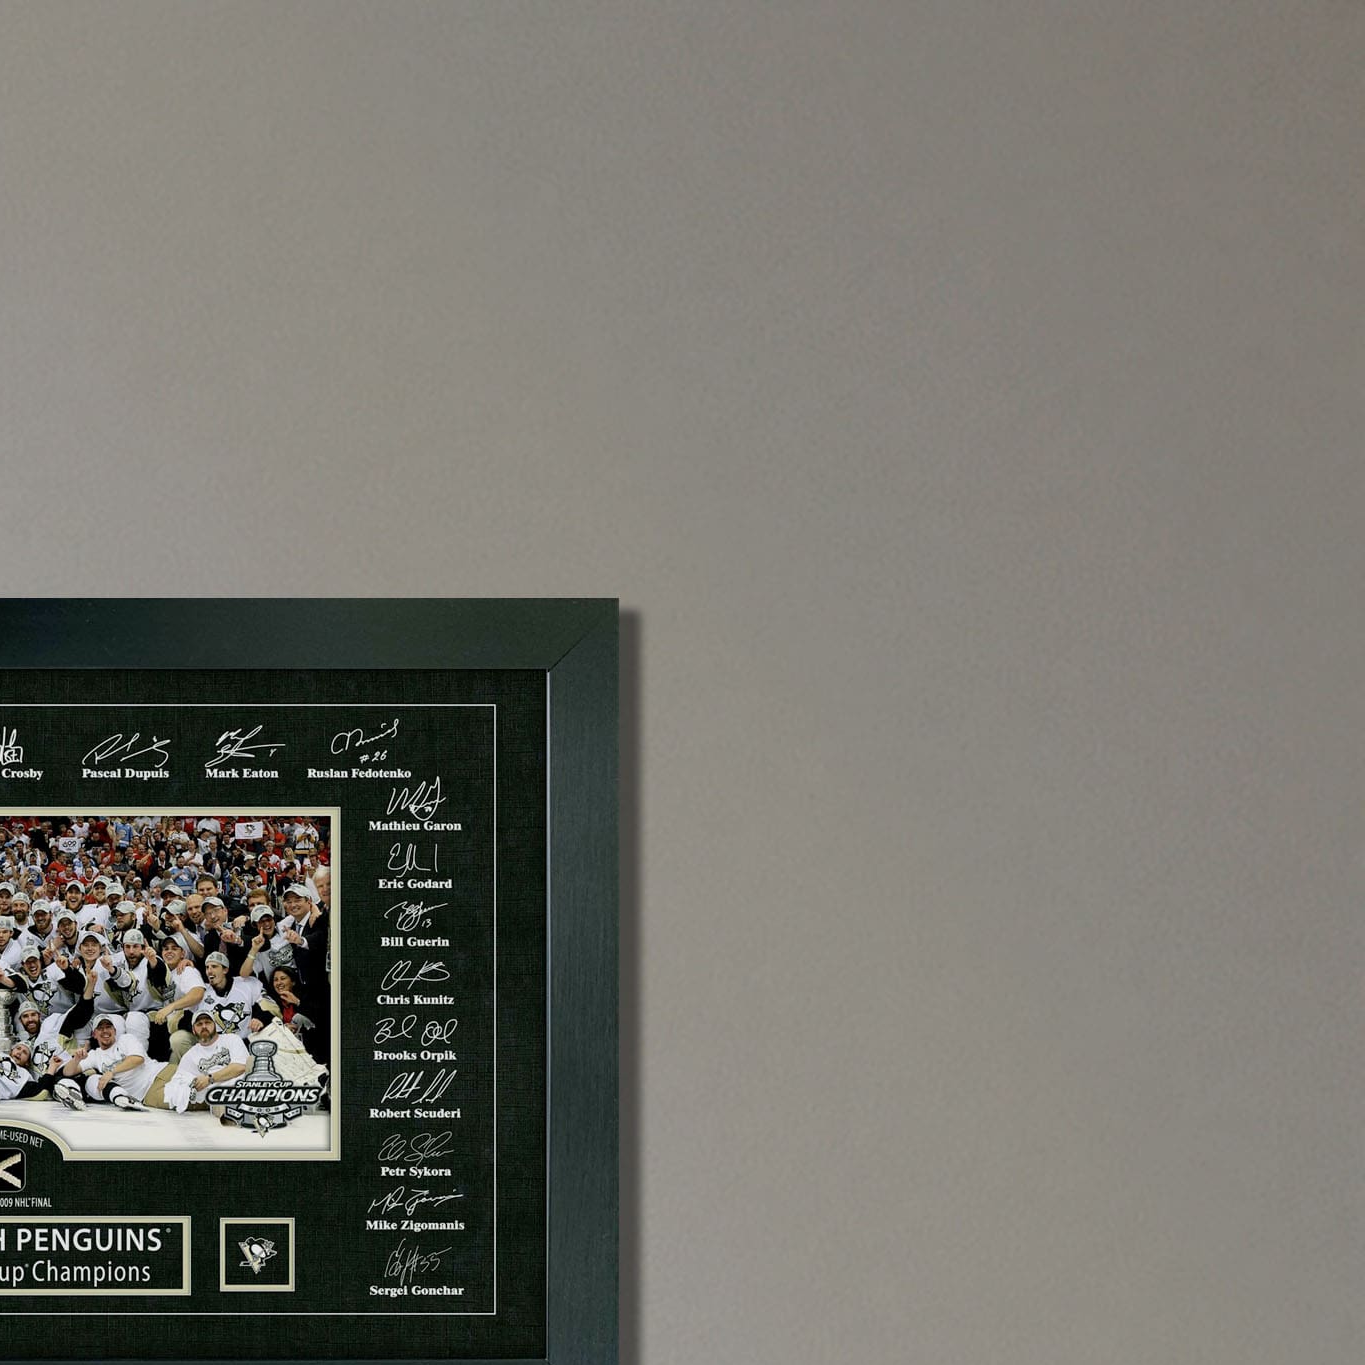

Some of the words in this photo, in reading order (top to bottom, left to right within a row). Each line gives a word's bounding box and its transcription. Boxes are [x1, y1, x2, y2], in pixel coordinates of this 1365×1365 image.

[1, 768, 44, 781] Crosby
[81, 768, 122, 779] Pascal
[124, 767, 170, 781] Dupuis
[205, 768, 240, 779] Mark
[242, 768, 279, 779] Eaton
[307, 768, 349, 779] Ruslan
[351, 768, 412, 779] Fedotenko
[368, 820, 421, 831] Mathieu
[422, 820, 462, 831] Garon
[378, 878, 405, 889] Eric
[406, 878, 453, 889] Godard
[380, 936, 404, 947] Bill
[406, 936, 450, 947] Guerin
[376, 994, 411, 1005] Chris
[413, 994, 455, 1005] Kunitz
[373, 1050, 418, 1061] Brooks
[419, 1050, 457, 1063] Orpik
[207, 1088, 320, 1102] CHAMPIONS
[369, 1108, 411, 1119] Robert
[413, 1108, 461, 1119] Scuderi
[29, 1135, 45, 1149] NET
[380, 1166, 407, 1177] Petr
[408, 1166, 452, 1179] Sykora
[31, 1197, 53, 1208] FINAL
[366, 1219, 398, 1231] Mike
[400, 1219, 465, 1233] Zigomanis
[17, 1228, 162, 1251] PENGUINS
[32, 1259, 151, 1288] Champions
[369, 1285, 408, 1298] Sergei
[411, 1285, 465, 1296] Gonchar
